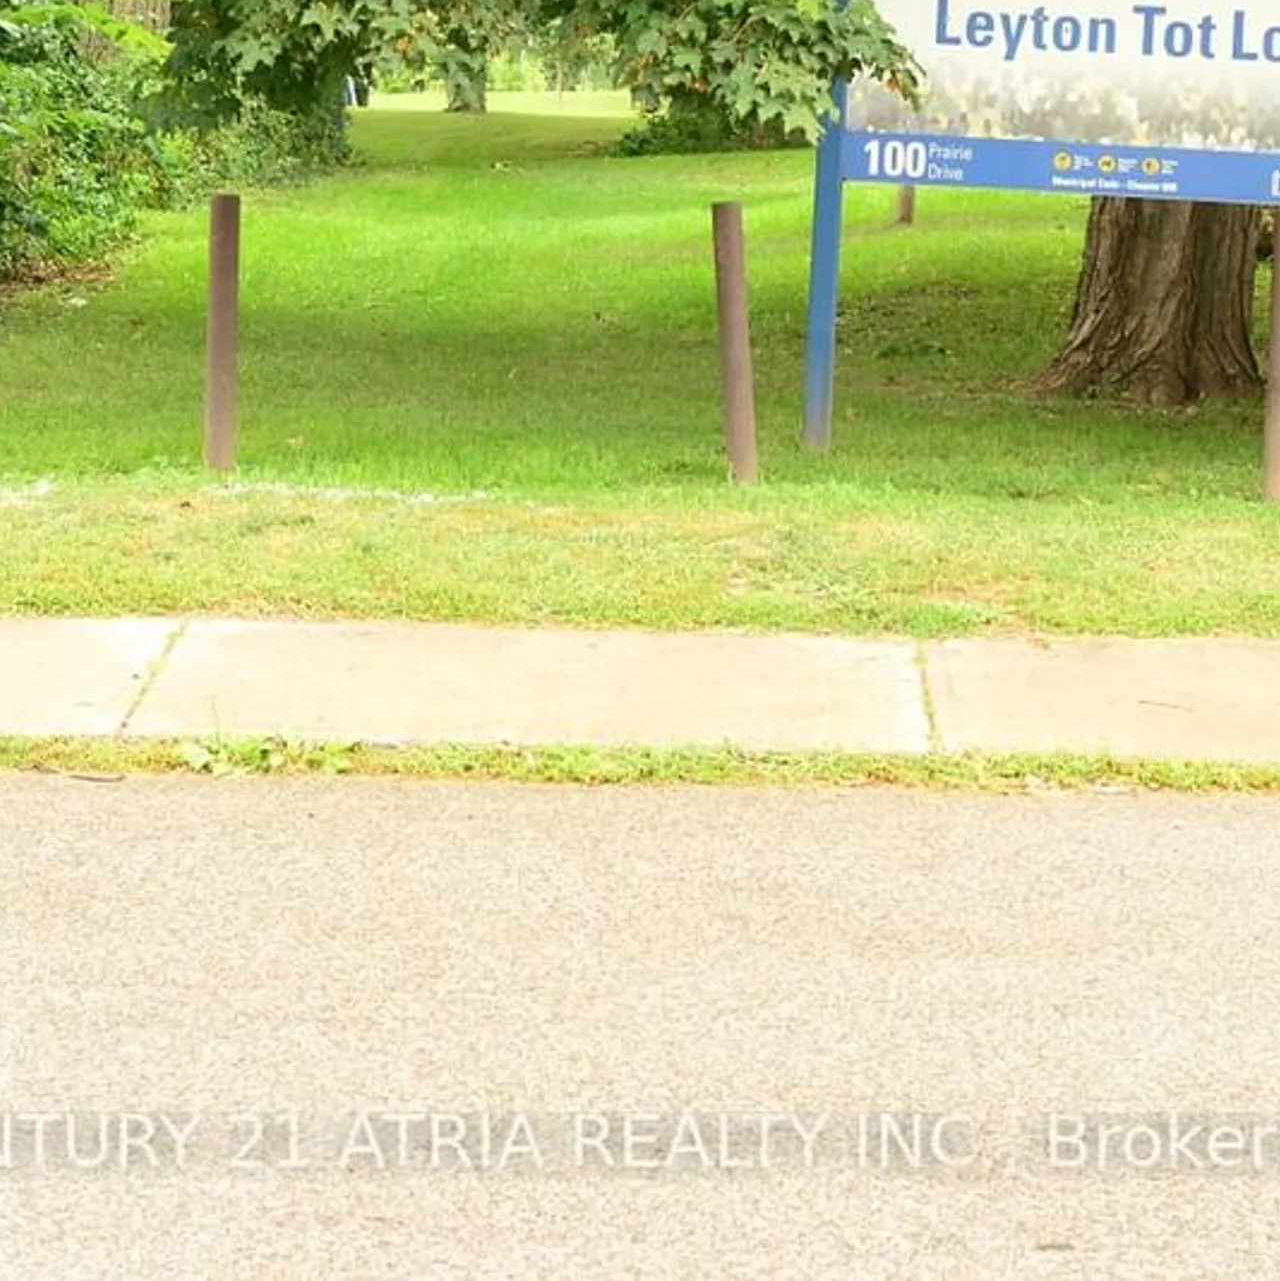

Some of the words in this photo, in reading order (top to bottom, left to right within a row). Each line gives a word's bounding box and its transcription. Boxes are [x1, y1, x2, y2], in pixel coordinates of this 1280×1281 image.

[1132, 4, 1217, 60] Tot
[863, 138, 927, 178] 100
[927, 141, 973, 161] Prairie
[927, 162, 965, 180] Drive
